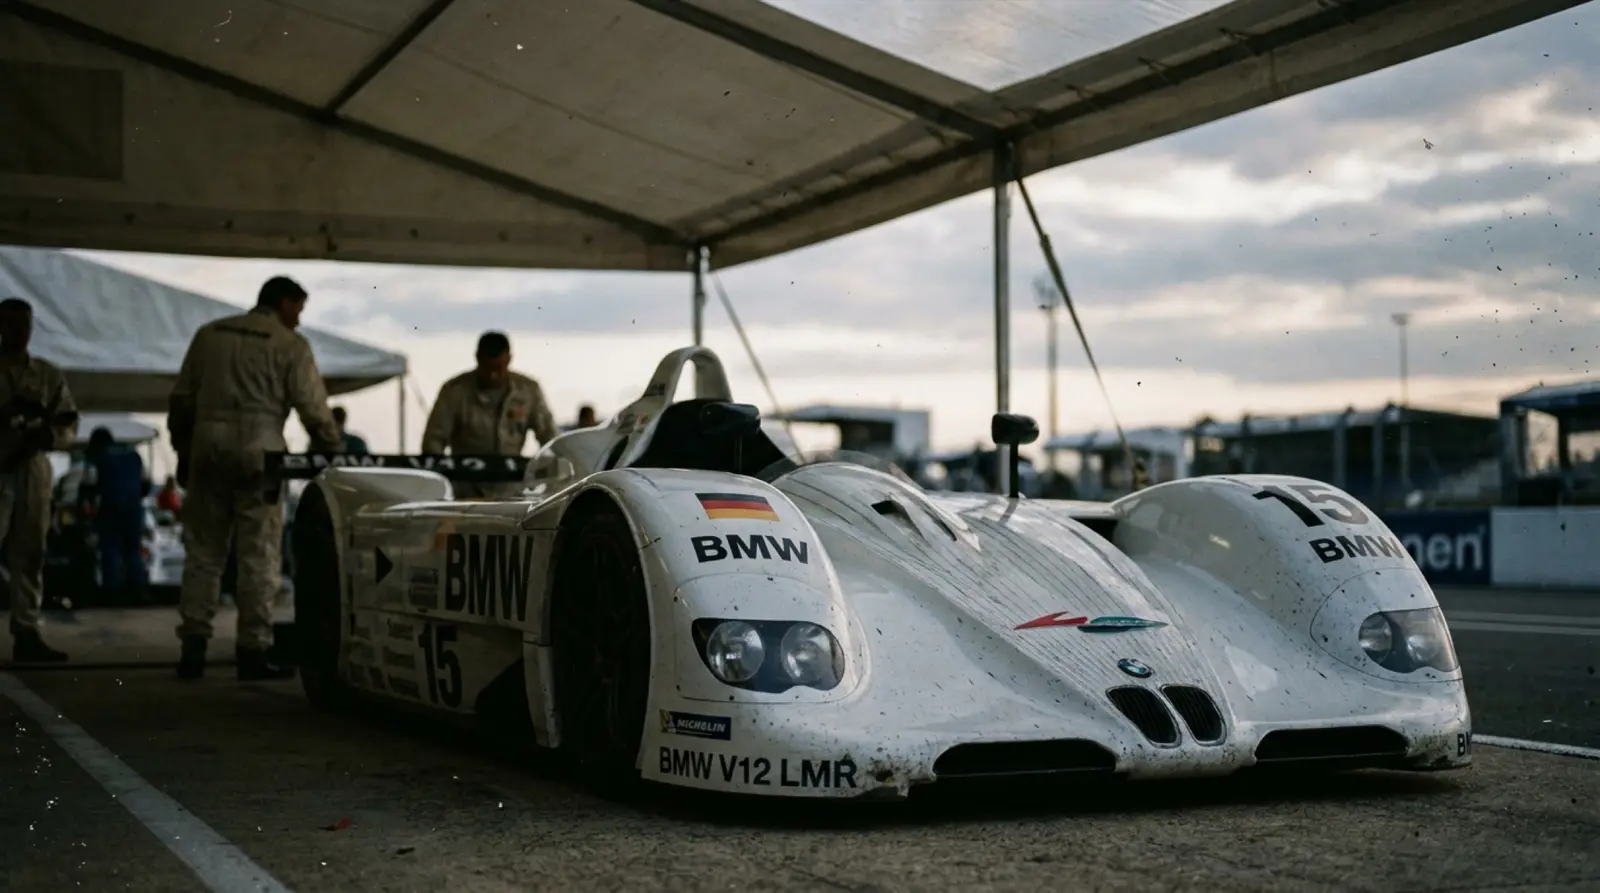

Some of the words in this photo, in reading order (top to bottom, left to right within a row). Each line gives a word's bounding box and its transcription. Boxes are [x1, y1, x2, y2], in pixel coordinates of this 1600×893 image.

[1253, 484, 1369, 527] 15
[690, 535, 808, 564] BMW
[1309, 534, 1405, 564] BMW
[445, 534, 534, 622] BMW
[418, 623, 462, 709] 15
[659, 746, 714, 786] BMW
[718, 753, 772, 787] V12
[780, 759, 857, 788] LMR
